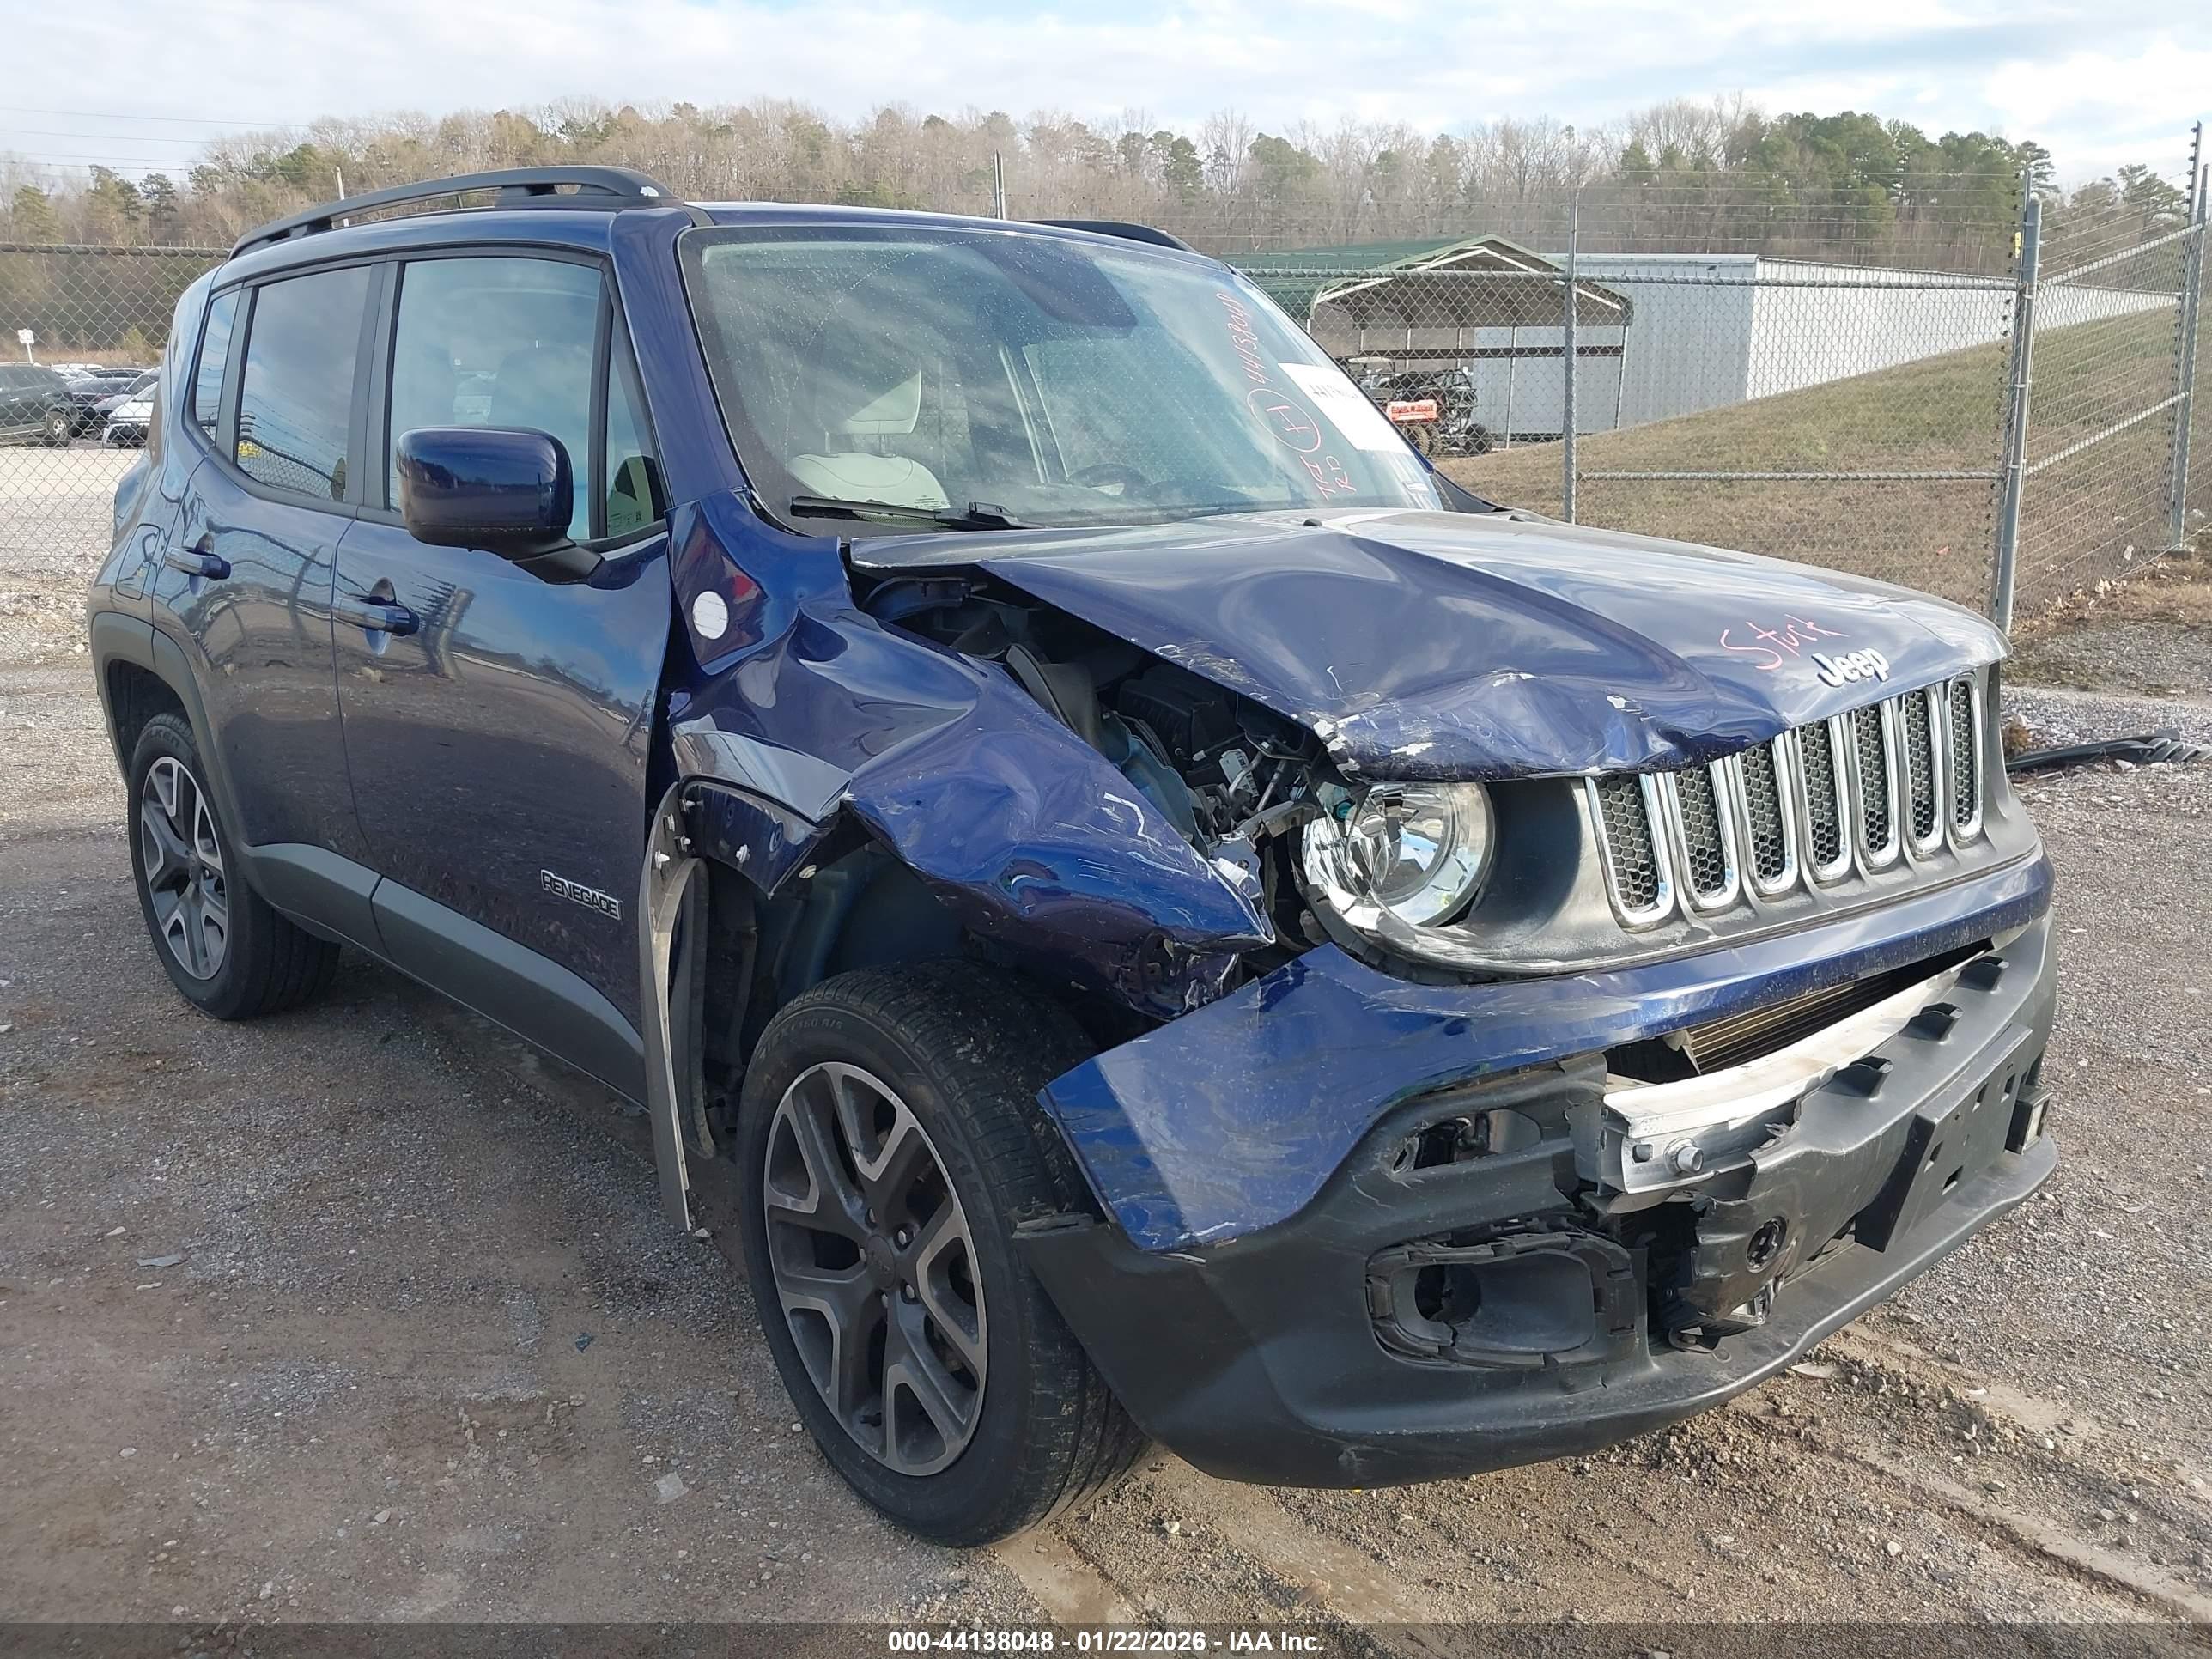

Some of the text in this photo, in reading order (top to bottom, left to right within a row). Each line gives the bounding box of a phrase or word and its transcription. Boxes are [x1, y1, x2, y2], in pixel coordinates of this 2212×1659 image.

[1216, 293, 1273, 384] 44138048
[1811, 647, 1890, 687] Jeep
[541, 869, 622, 921] RENEGADE
